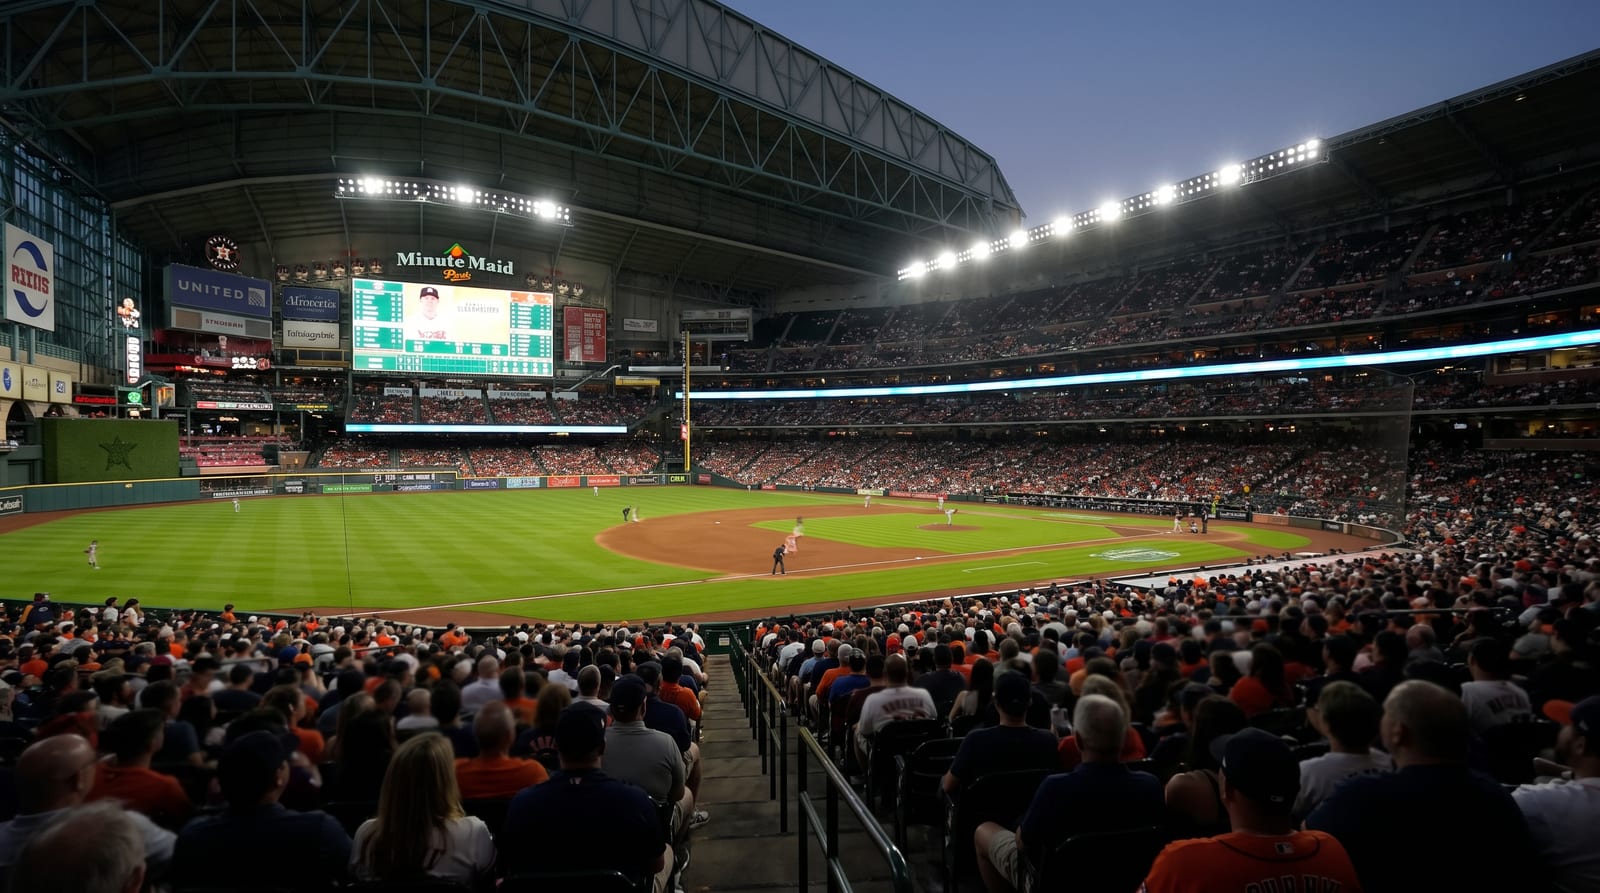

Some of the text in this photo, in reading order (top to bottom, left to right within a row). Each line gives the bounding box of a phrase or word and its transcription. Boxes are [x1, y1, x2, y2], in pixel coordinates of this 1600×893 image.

[397, 252, 514, 276] Minute Maid
[178, 279, 244, 300] UNITED
